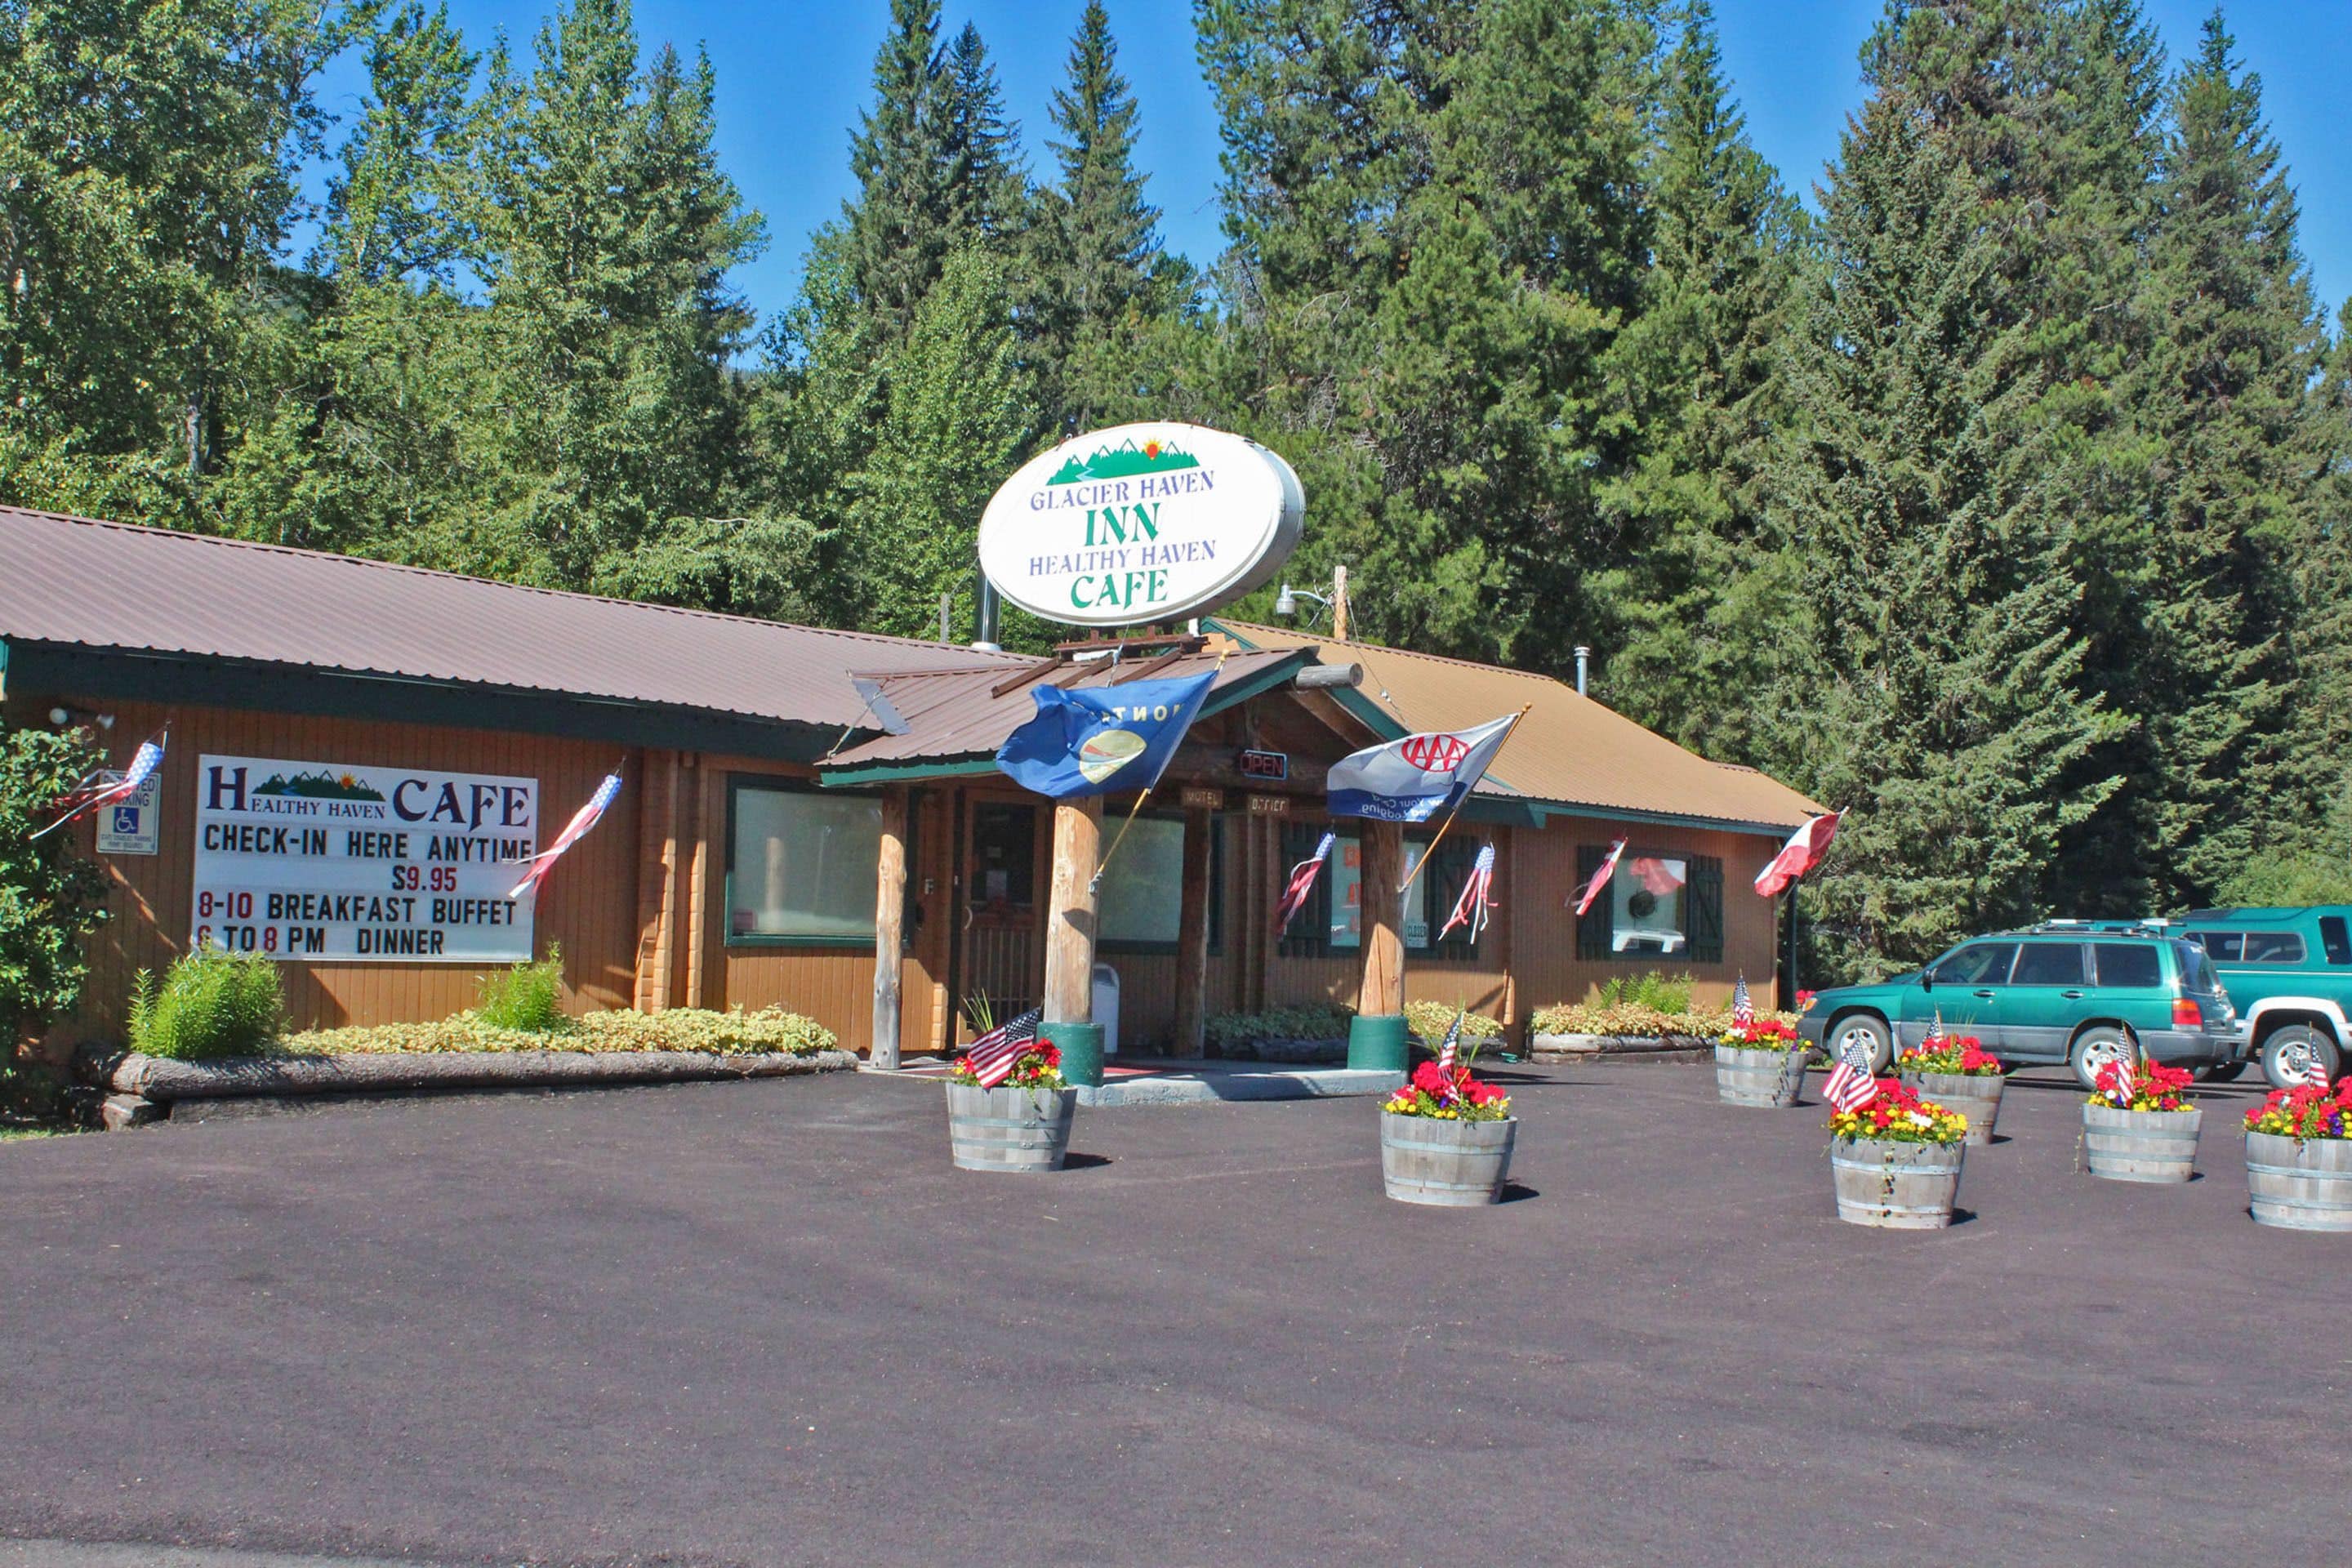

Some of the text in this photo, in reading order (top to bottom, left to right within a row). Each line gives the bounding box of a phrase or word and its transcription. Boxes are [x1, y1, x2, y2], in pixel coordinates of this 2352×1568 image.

[1030, 470, 1214, 511] GLACIER HAVEN
[1084, 502, 1160, 546] INN
[1029, 540, 1216, 576] HEALTHY HAVEN
[1071, 569, 1168, 610] CAFE
[1241, 754, 1283, 776] OPEN
[207, 765, 530, 833] HEALTHY HAVEN CAFE
[203, 824, 532, 864] CHECK-IN HERE ANYTIME
[198, 891, 518, 926] 8-10 BREAKFAST BUFFET
[223, 926, 256, 952] TO
[264, 926, 277, 952] 8
[288, 927, 325, 953] PM
[358, 929, 444, 955] DINNER
